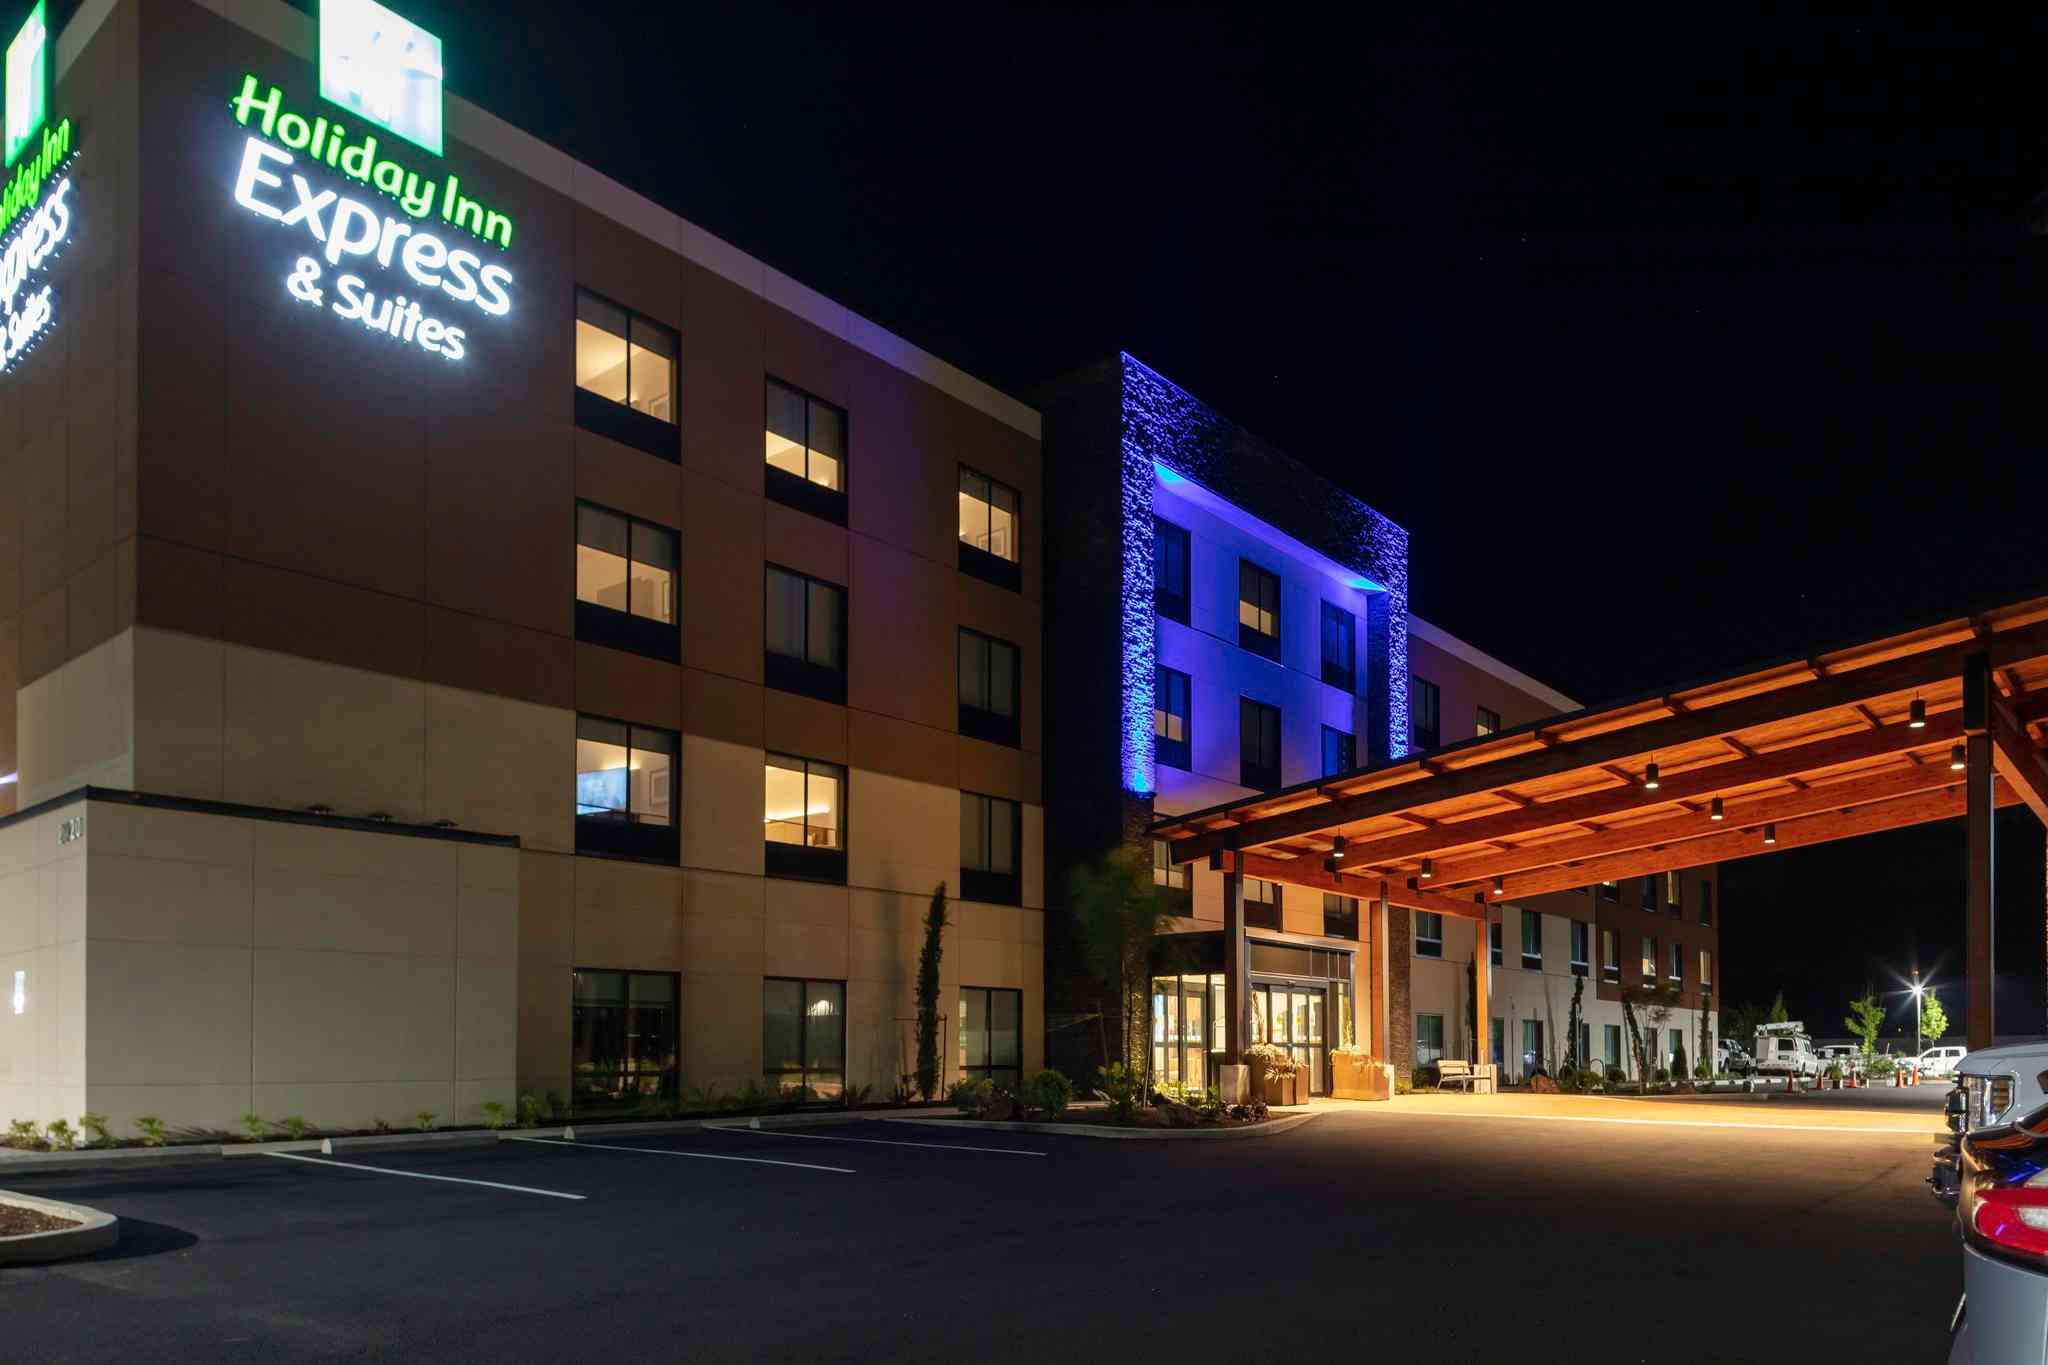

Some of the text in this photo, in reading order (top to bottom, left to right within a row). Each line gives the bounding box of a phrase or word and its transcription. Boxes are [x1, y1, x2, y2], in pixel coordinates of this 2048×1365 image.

[0, 118, 70, 236] liday Inn
[233, 74, 513, 249] Holiday Inn
[234, 136, 513, 316] Express
[0, 178, 70, 316] press
[286, 256, 465, 360] & Suites
